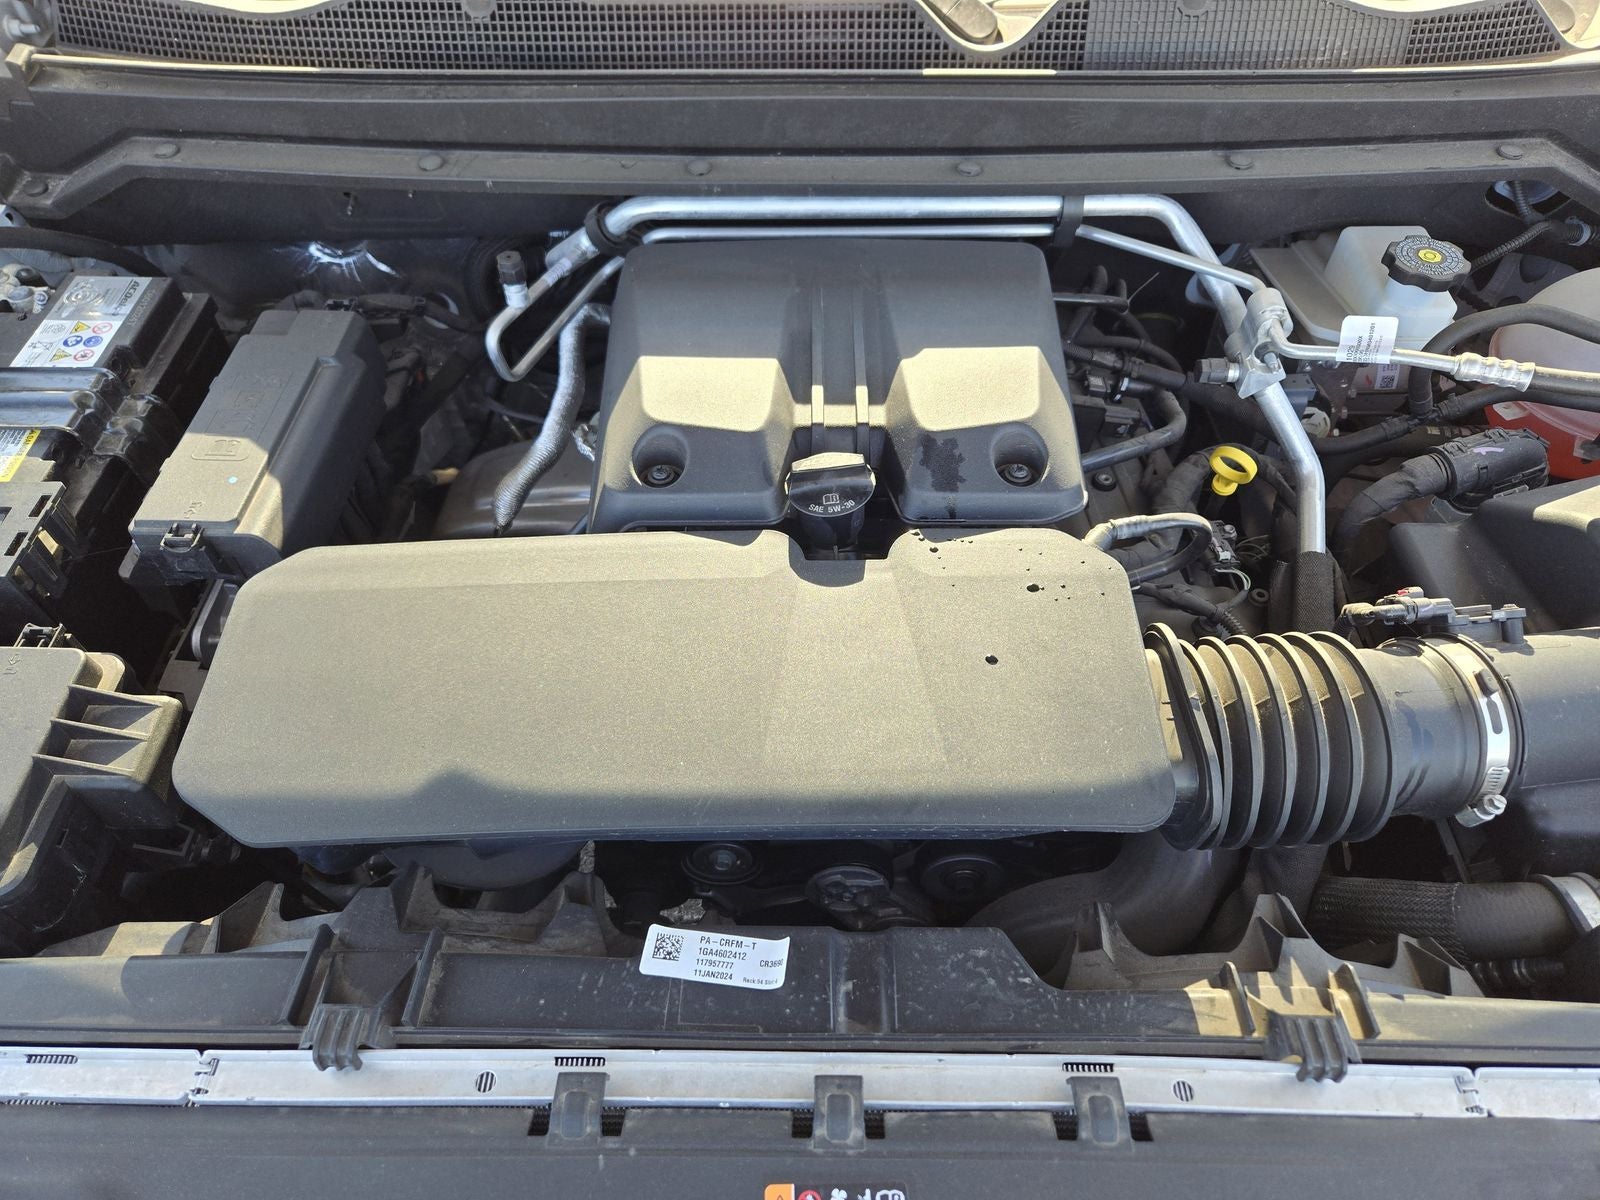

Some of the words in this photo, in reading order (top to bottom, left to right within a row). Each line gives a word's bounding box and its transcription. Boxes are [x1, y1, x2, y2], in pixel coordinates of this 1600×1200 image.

[808, 503, 824, 513] SAE
[828, 499, 856, 513] 5W-30
[698, 947, 747, 961] 1GA4602412
[695, 958, 734, 970] 117957777
[693, 969, 733, 981] 11JAN2024
